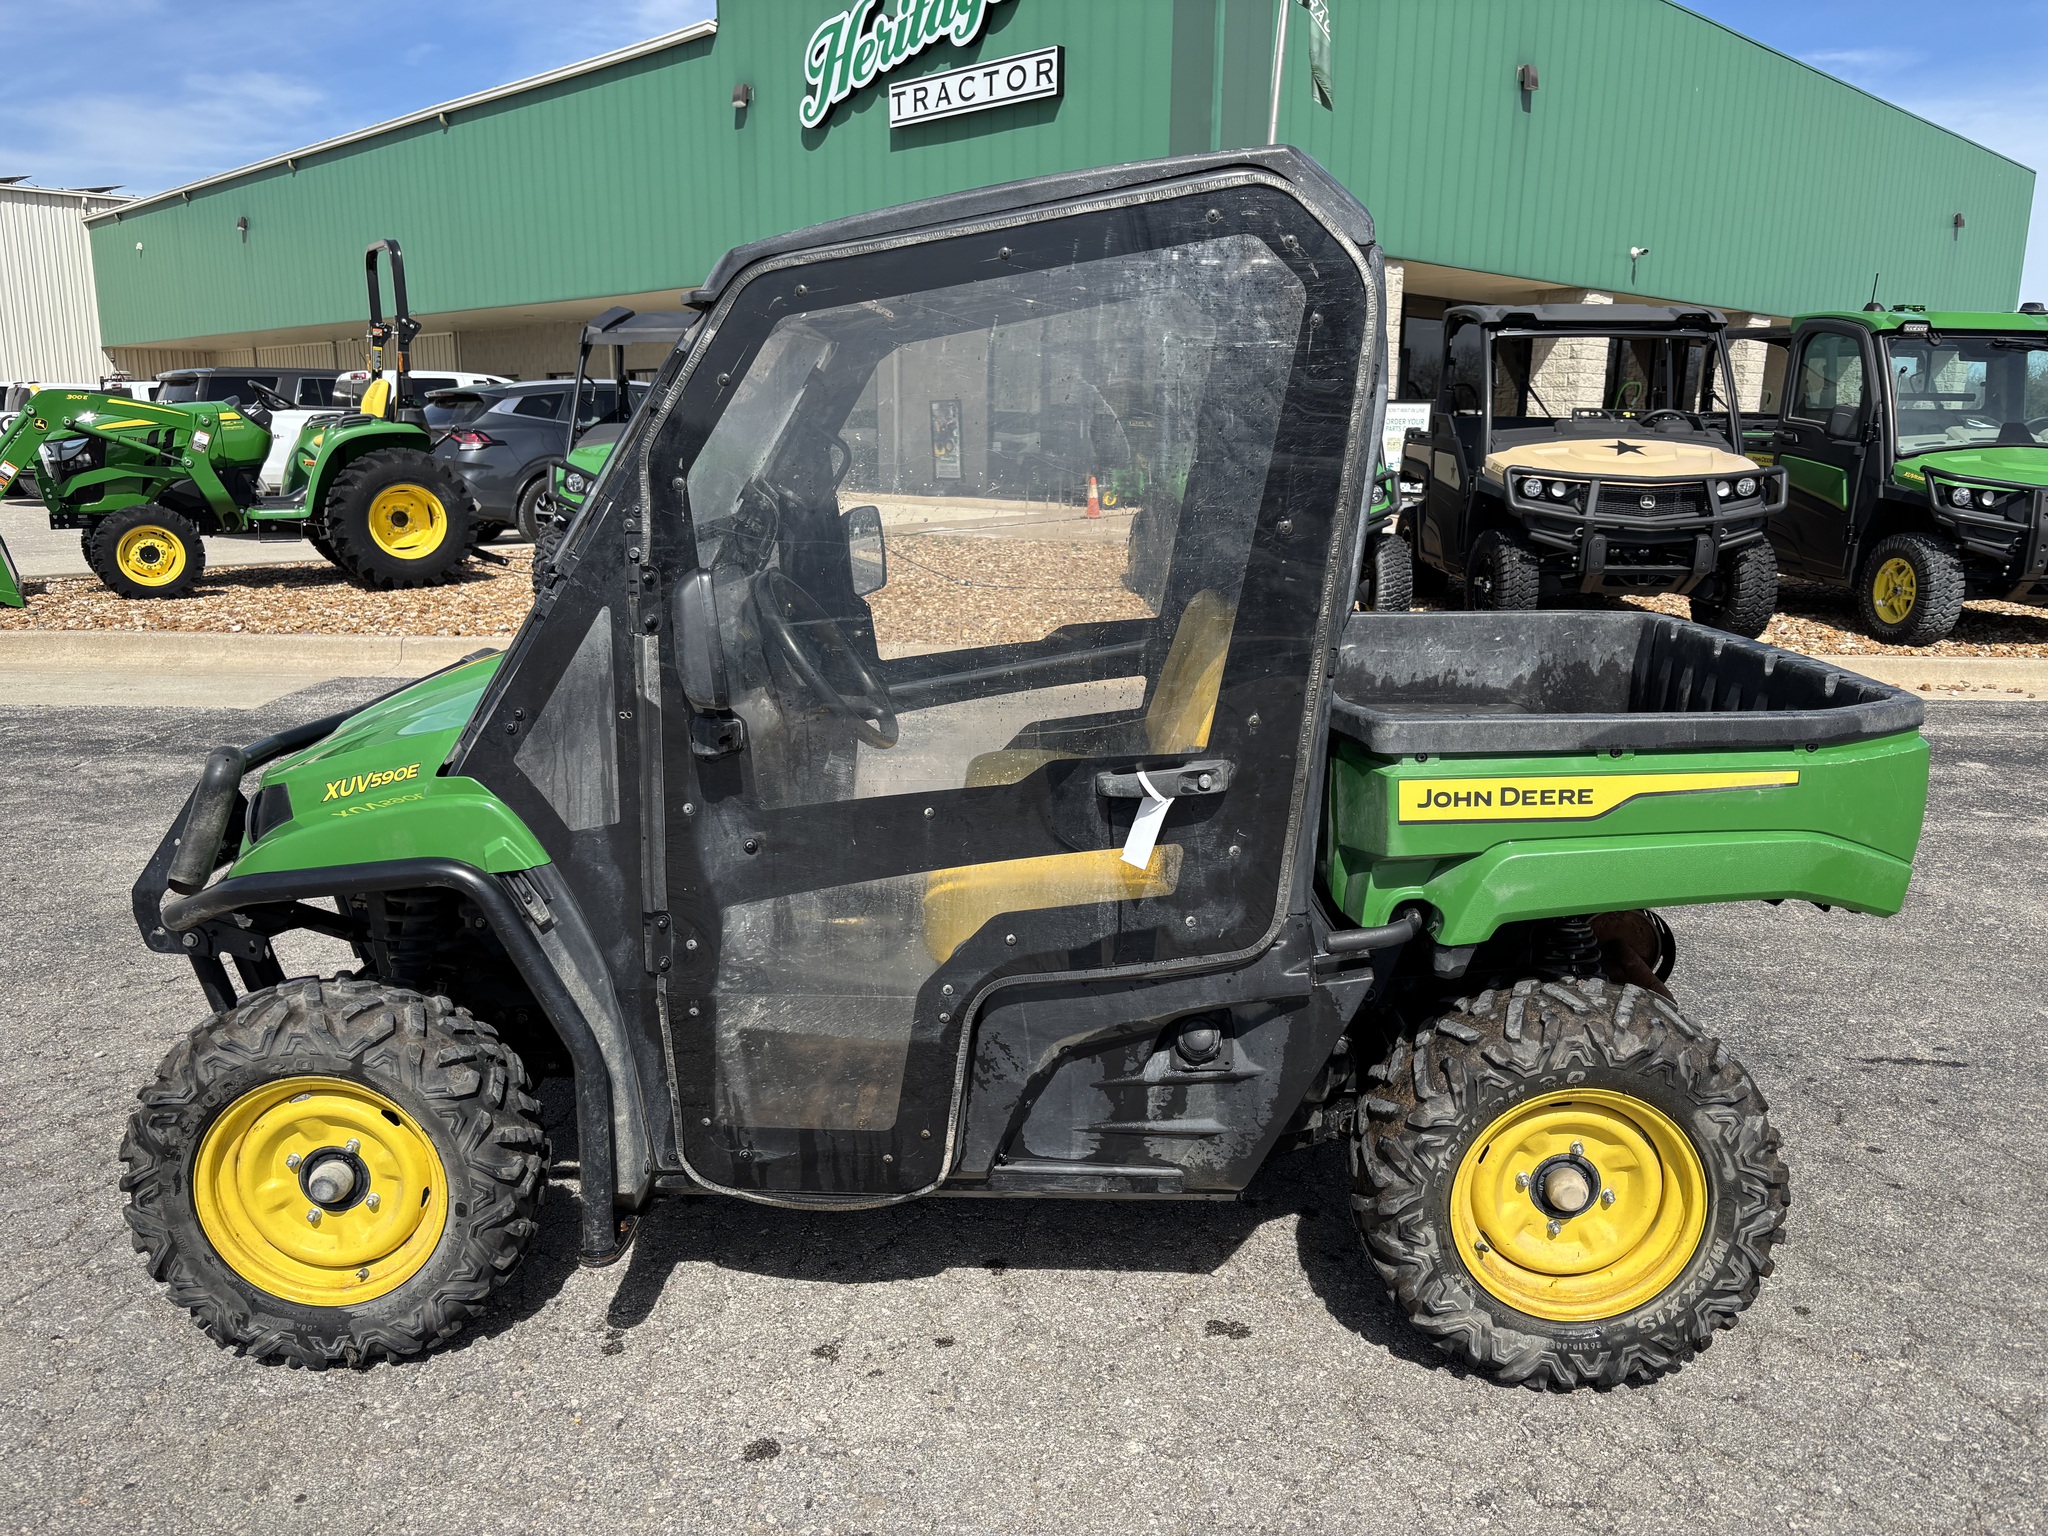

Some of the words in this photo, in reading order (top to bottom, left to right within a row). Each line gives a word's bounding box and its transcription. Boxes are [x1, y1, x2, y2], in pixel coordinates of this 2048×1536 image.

[800, 0, 1002, 128] Heritag
[891, 57, 1055, 117] TRACTOR
[320, 762, 421, 803] XUV590E
[1417, 789, 1492, 809] JOHN
[1500, 787, 1594, 807] DEERE
[1636, 1236, 1730, 1335] MAXXIS
